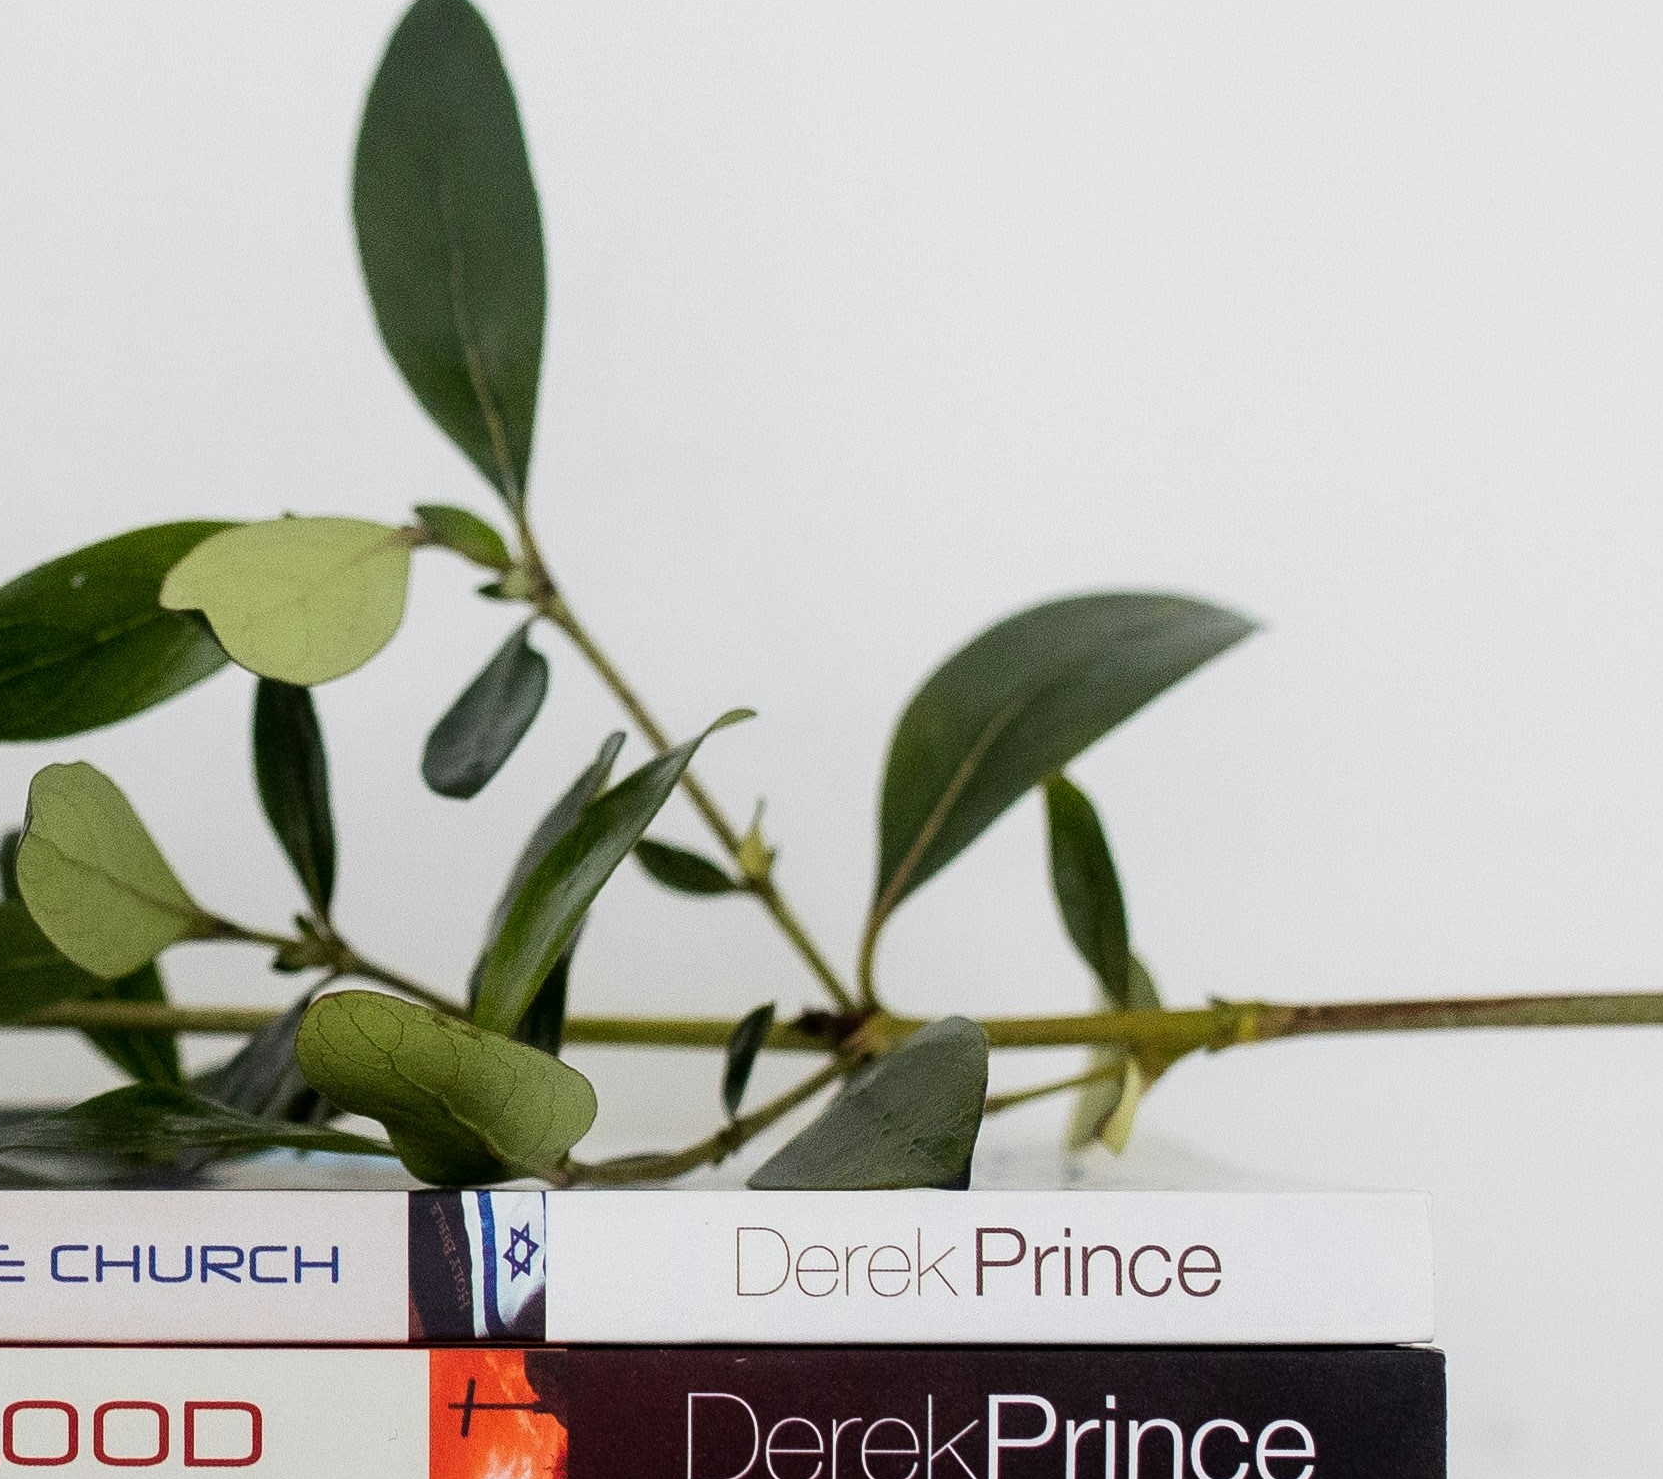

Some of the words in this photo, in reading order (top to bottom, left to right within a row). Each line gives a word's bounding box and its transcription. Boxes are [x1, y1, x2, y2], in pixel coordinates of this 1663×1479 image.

[49, 1243, 341, 1285] CHURCH
[735, 1225, 960, 1299] Derek
[974, 1226, 1223, 1299] Prince
